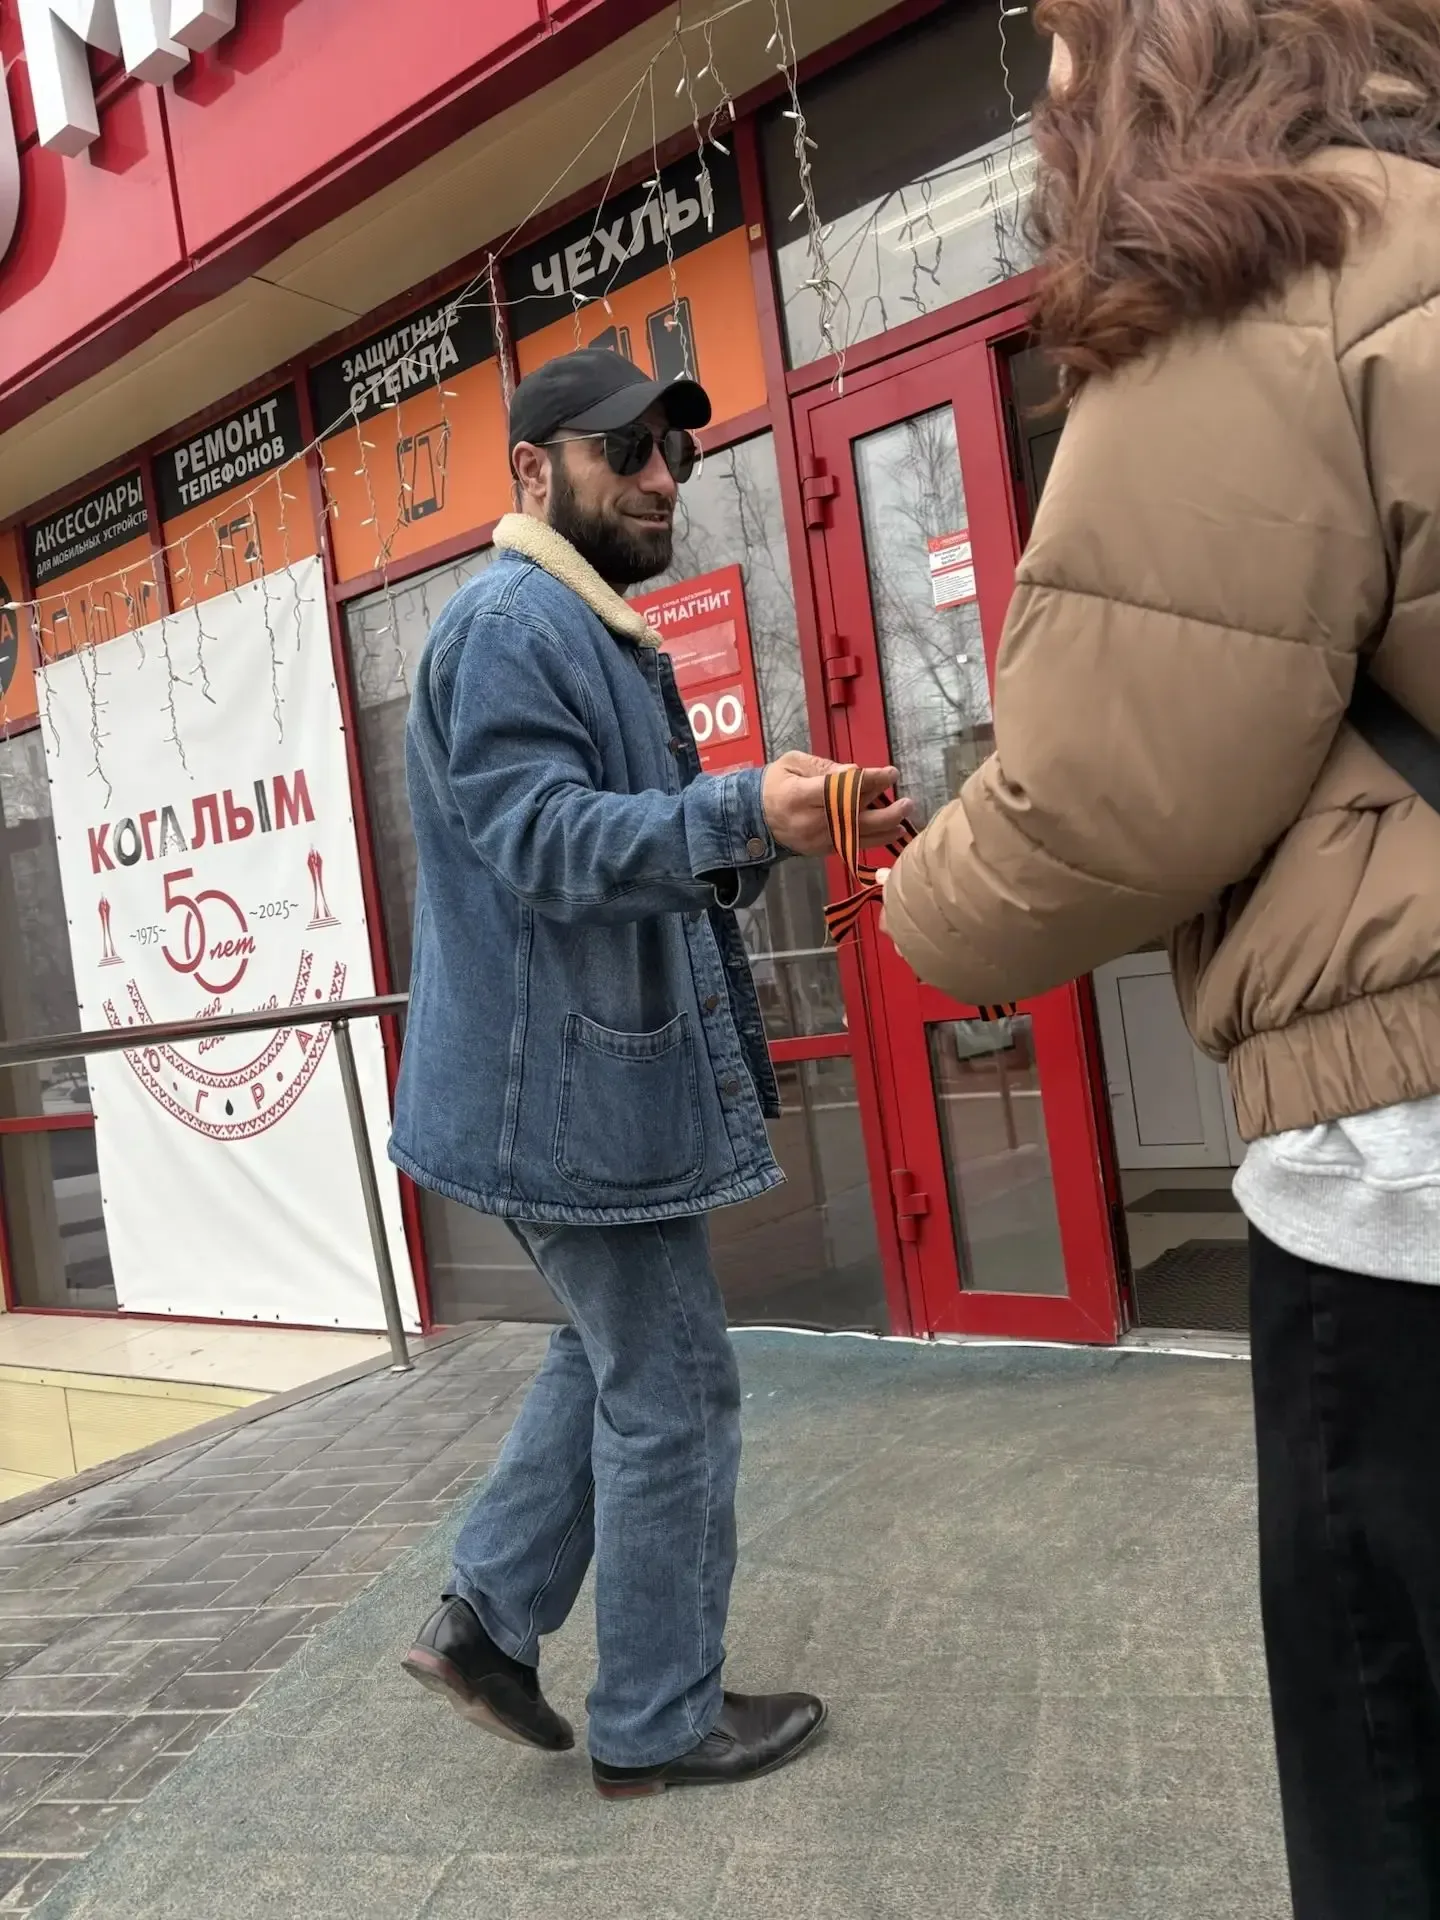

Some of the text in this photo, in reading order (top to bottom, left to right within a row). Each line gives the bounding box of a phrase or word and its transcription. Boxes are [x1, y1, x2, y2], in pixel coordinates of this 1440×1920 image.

[531, 174, 715, 296] ЧЕХЛЫ
[341, 301, 459, 382] ЗАЩИТНЫЕ
[350, 335, 460, 413] СТЕКЛА
[174, 398, 278, 481] РЕМОНТ
[178, 436, 285, 505] ТЕЛЕФОНОВ
[34, 476, 143, 557] АКСЕССУАРЫ
[36, 509, 148, 579] ДЛЯ МОБИЛЬНЫХ УСТРОЙСТВ
[663, 589, 731, 625] МАГНИТ
[87, 768, 316, 874] КОГАЛЫМ
[162, 867, 249, 995] 50
[210, 936, 256, 961] лет
